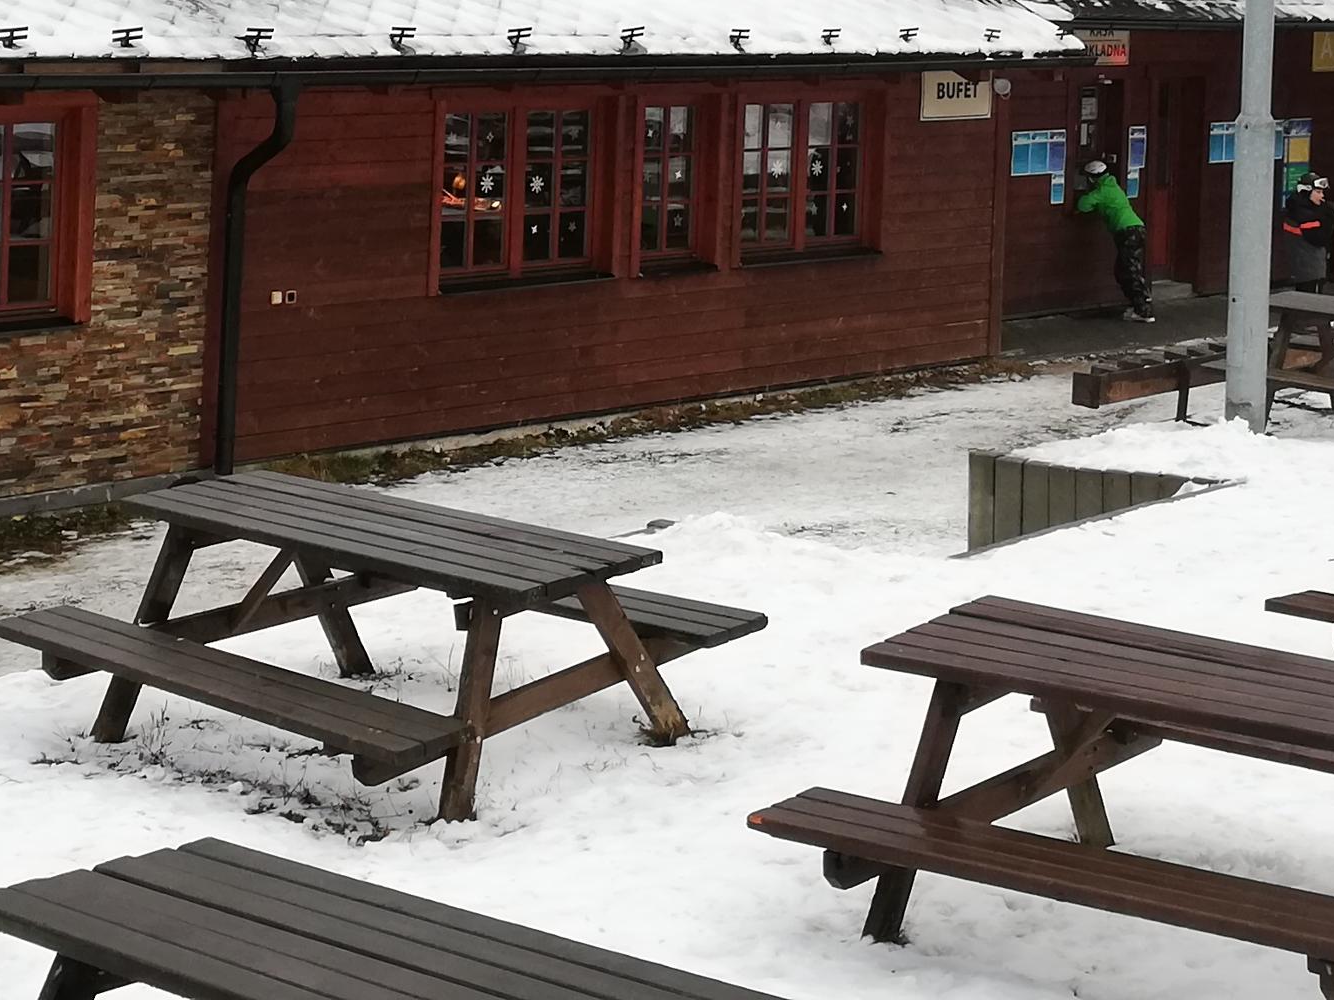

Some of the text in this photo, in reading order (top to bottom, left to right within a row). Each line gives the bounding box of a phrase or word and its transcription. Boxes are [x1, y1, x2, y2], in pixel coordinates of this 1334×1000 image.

[1085, 43, 1127, 56] KLADNA
[1320, 32, 1332, 58] A
[937, 81, 979, 100] BUFET
